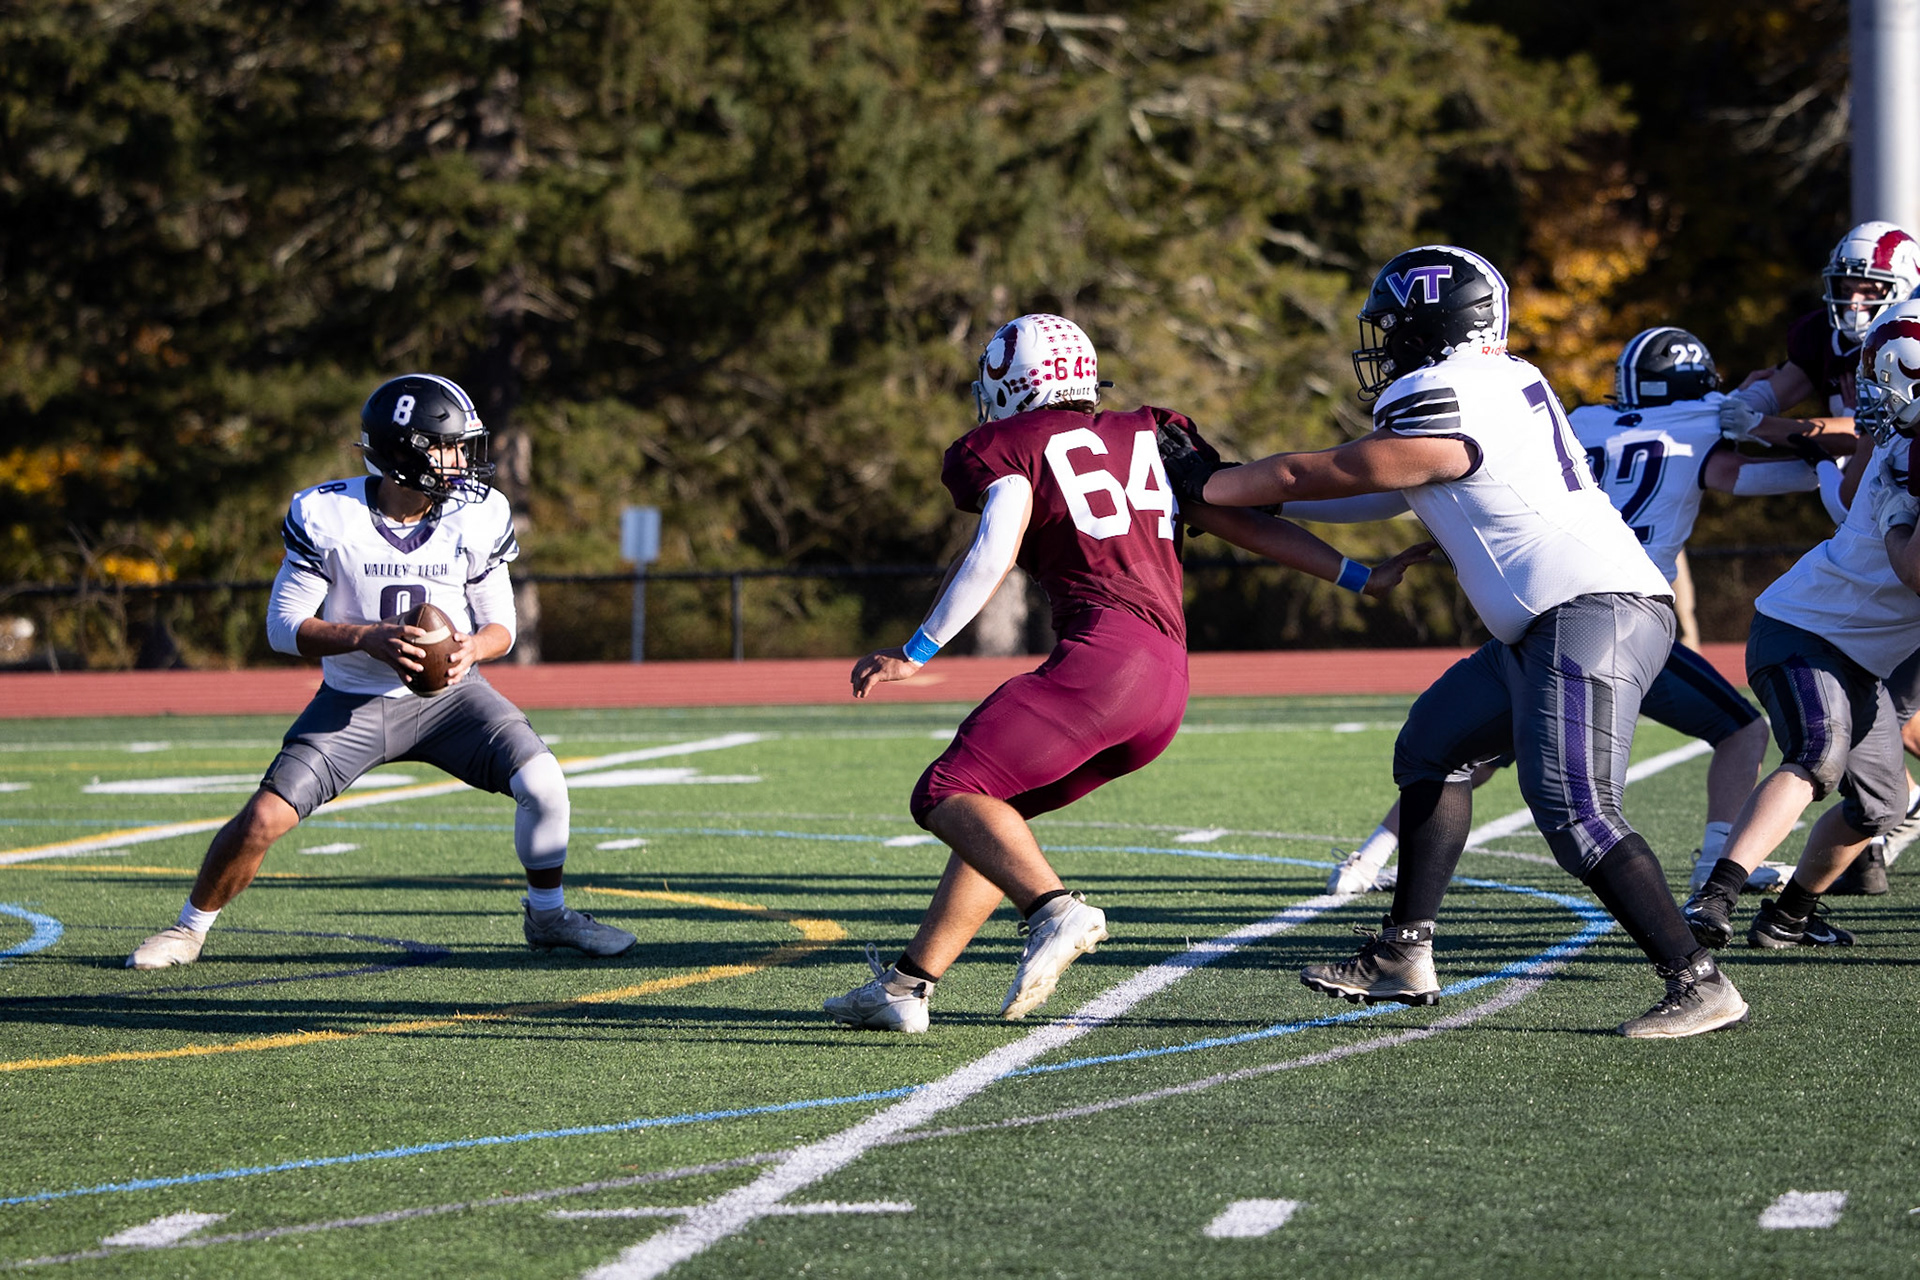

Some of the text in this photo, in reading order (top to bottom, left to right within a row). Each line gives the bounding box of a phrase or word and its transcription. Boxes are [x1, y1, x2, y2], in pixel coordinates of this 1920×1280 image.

[1386, 265, 1453, 308] VT
[1054, 356, 1084, 381] 64
[1670, 343, 1706, 372] 22
[392, 394, 416, 426] 8
[1044, 427, 1176, 541] 64
[363, 563, 450, 578] VALLEY TECH
